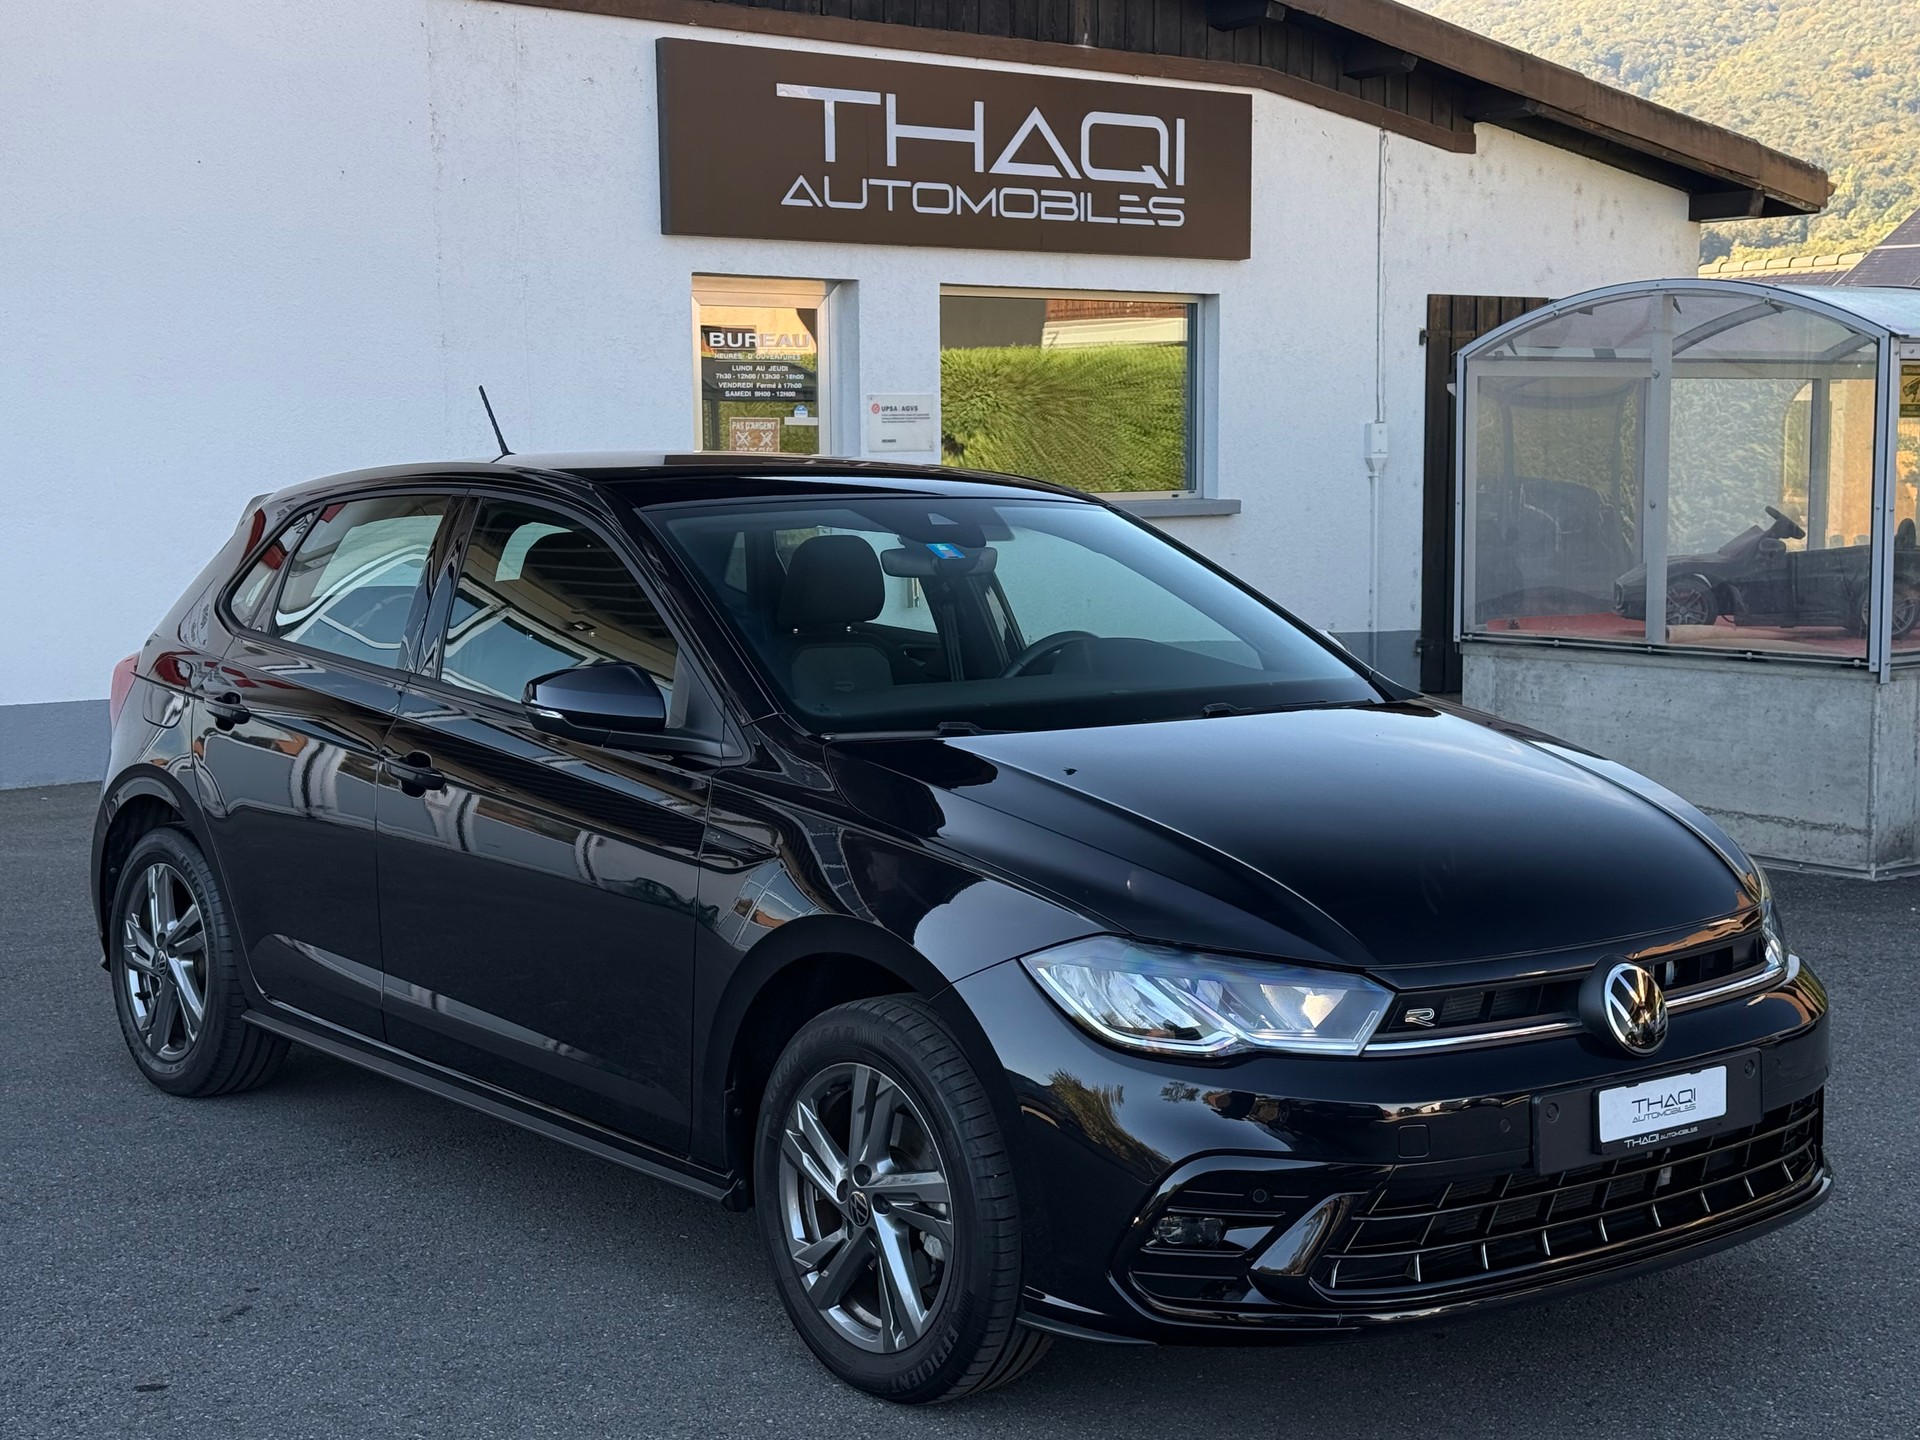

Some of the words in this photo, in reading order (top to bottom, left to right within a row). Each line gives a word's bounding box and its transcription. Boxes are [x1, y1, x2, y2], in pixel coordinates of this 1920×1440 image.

[776, 82, 1186, 189] THAQI
[780, 174, 1186, 227] AUTOMOBILES
[709, 332, 810, 348] BUREAU
[1631, 1087, 1697, 1114] THAQI
[1632, 1103, 1697, 1124] AUTOMOBILES
[1623, 1133, 1660, 1149] THAQI
